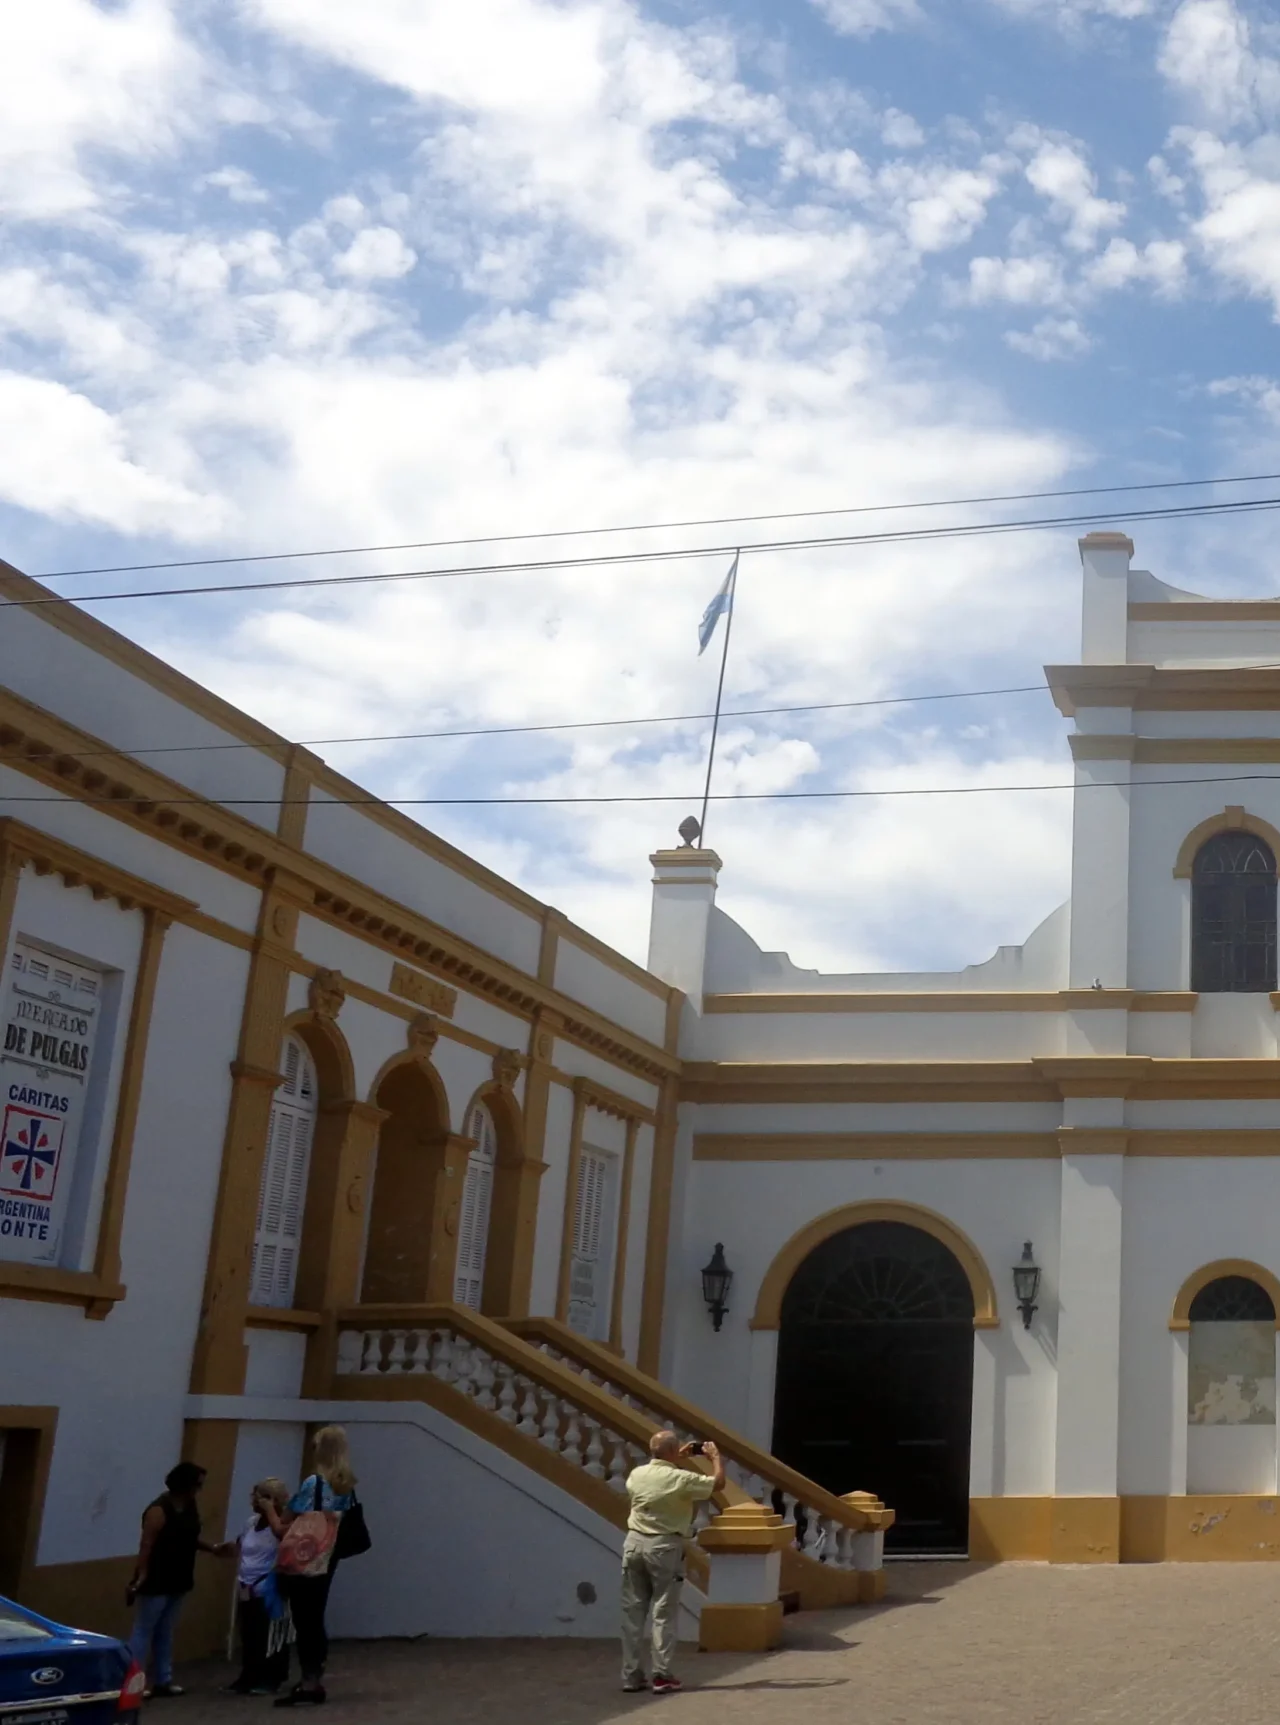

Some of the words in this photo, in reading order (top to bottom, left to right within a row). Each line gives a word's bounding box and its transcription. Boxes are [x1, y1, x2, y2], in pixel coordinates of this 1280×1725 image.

[16, 1000, 88, 1036] MERCADO
[4, 1023, 27, 1054] DE
[30, 1031, 89, 1071] PULGAS
[1, 1218, 49, 1241] ONTE
